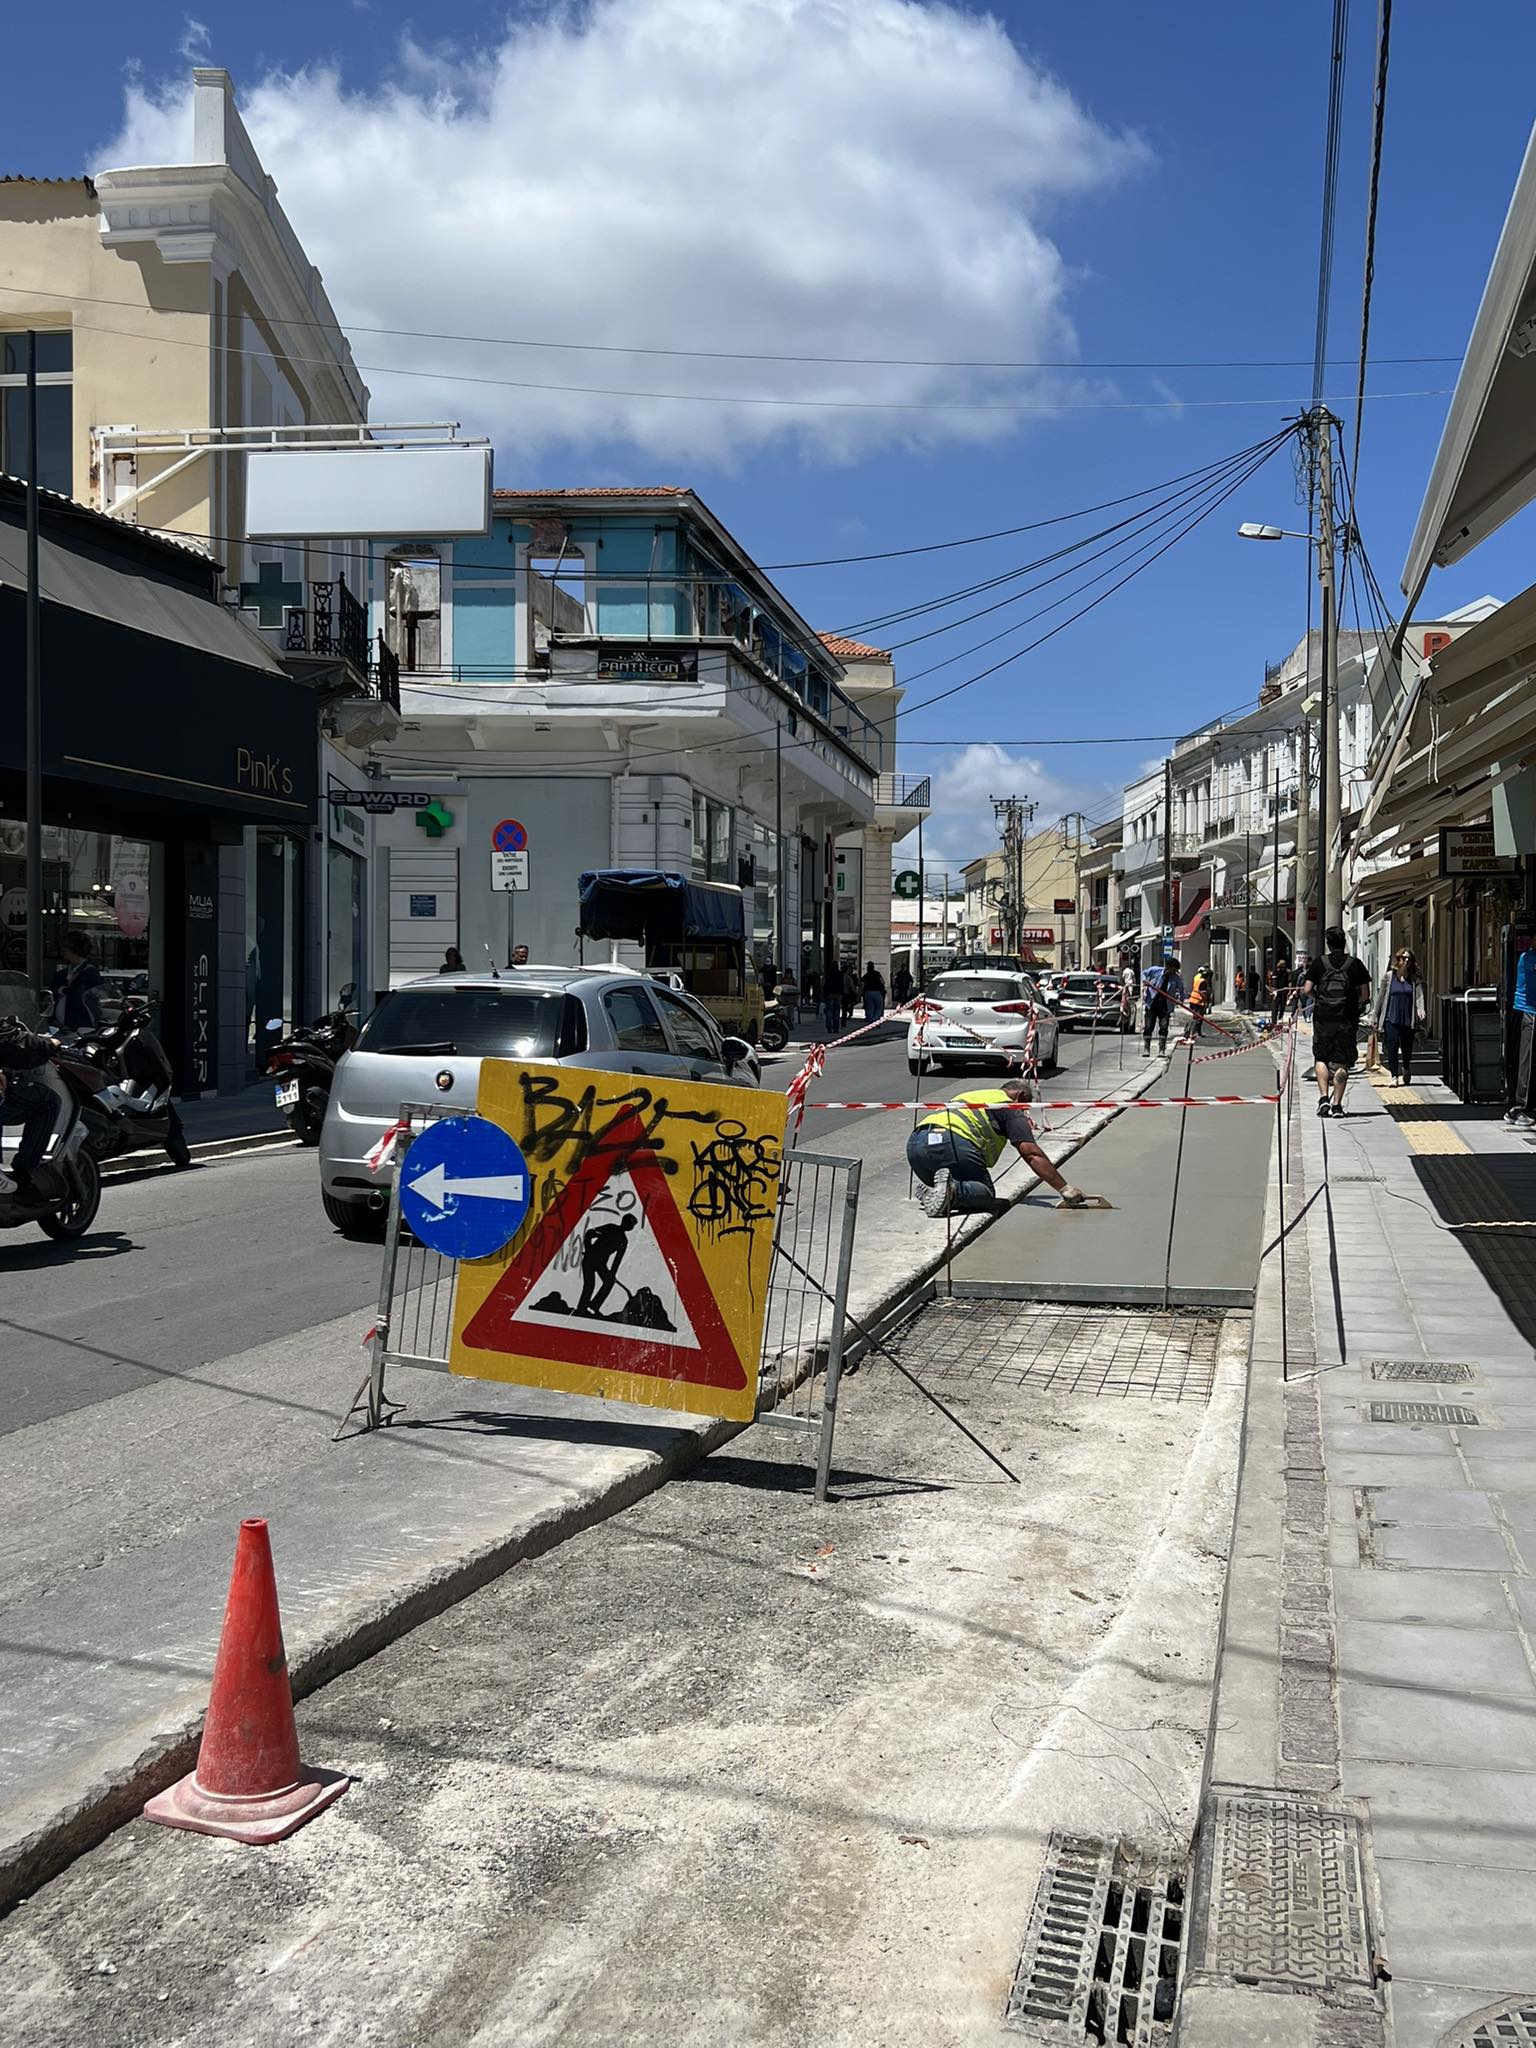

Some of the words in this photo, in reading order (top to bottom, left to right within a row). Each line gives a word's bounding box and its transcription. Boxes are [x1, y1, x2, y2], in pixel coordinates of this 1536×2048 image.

[236, 747, 293, 794] Pink's
[329, 791, 429, 805] EDWARD
[189, 894, 213, 907] MUA
[1163, 925, 1173, 937] P
[198, 954, 208, 1083] ELIXIR
